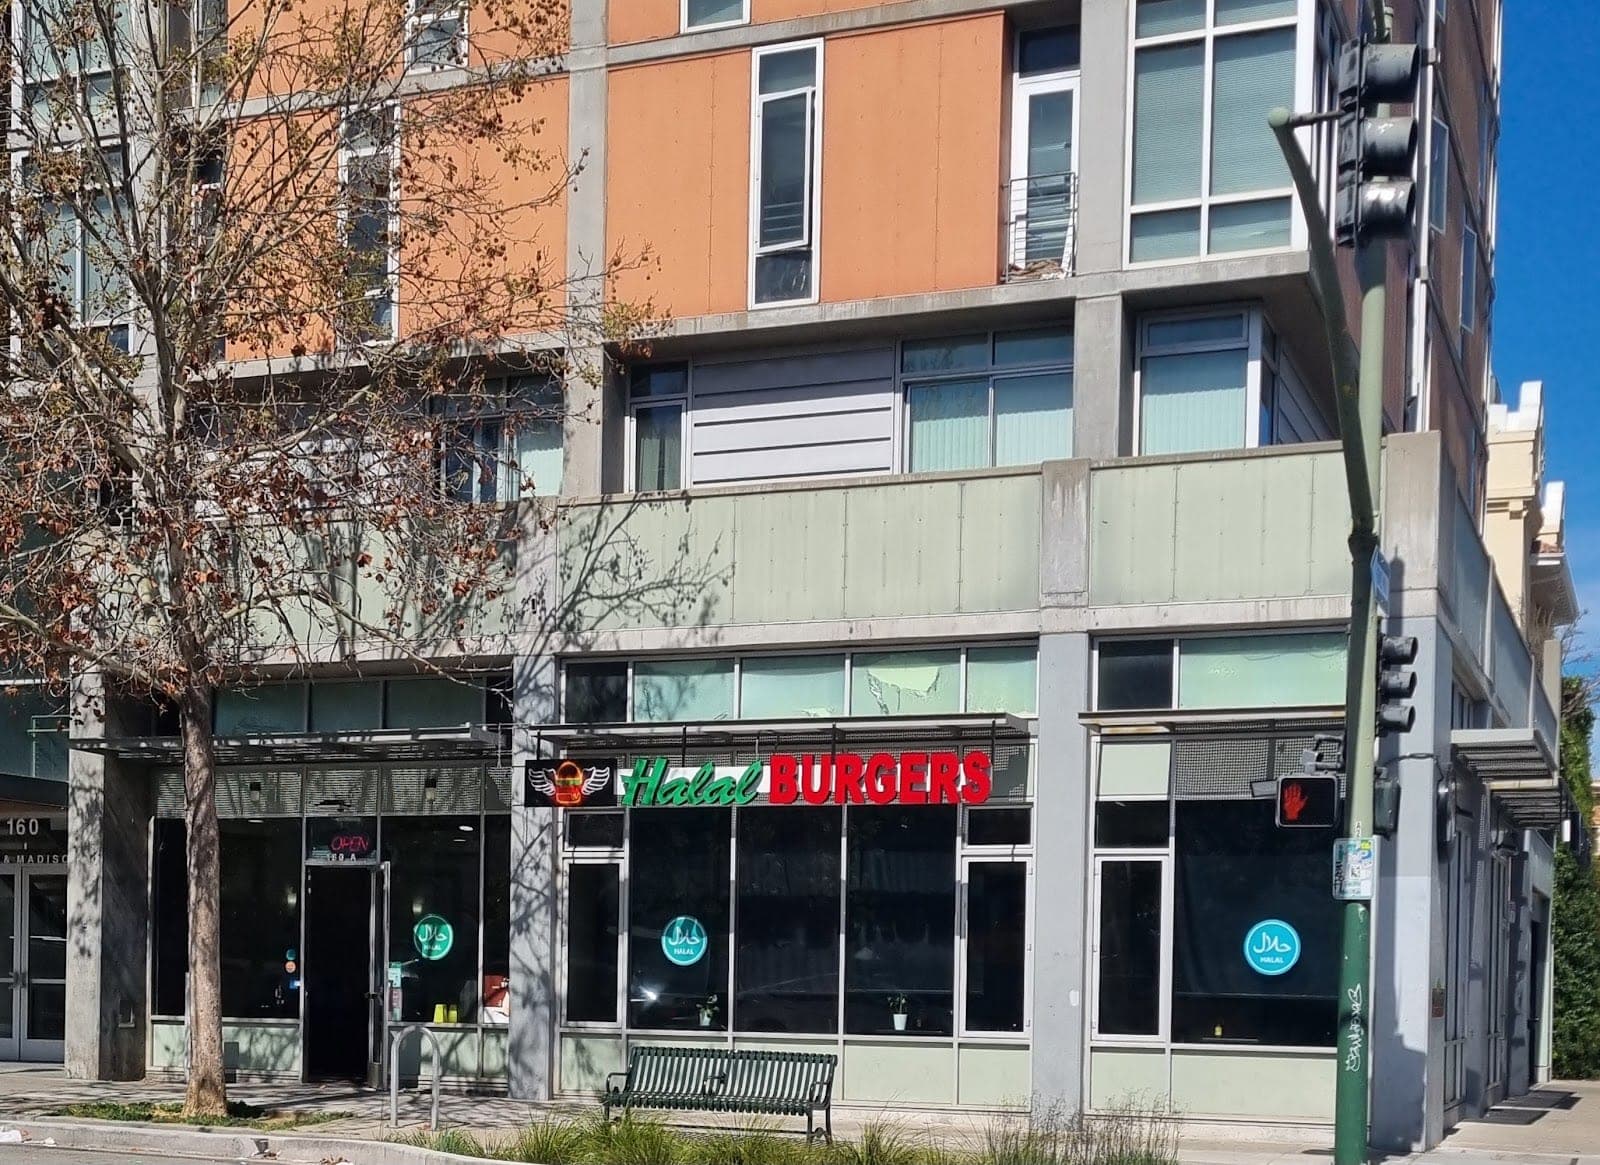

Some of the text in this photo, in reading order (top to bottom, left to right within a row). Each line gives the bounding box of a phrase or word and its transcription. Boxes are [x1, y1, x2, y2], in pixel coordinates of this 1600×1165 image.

[620, 750, 992, 806] Halal BURGERS
[6, 817, 39, 836] 160
[331, 836, 369, 851] OPEN
[1253, 931, 1291, 953] حلال
[1260, 956, 1284, 964] HALAL
